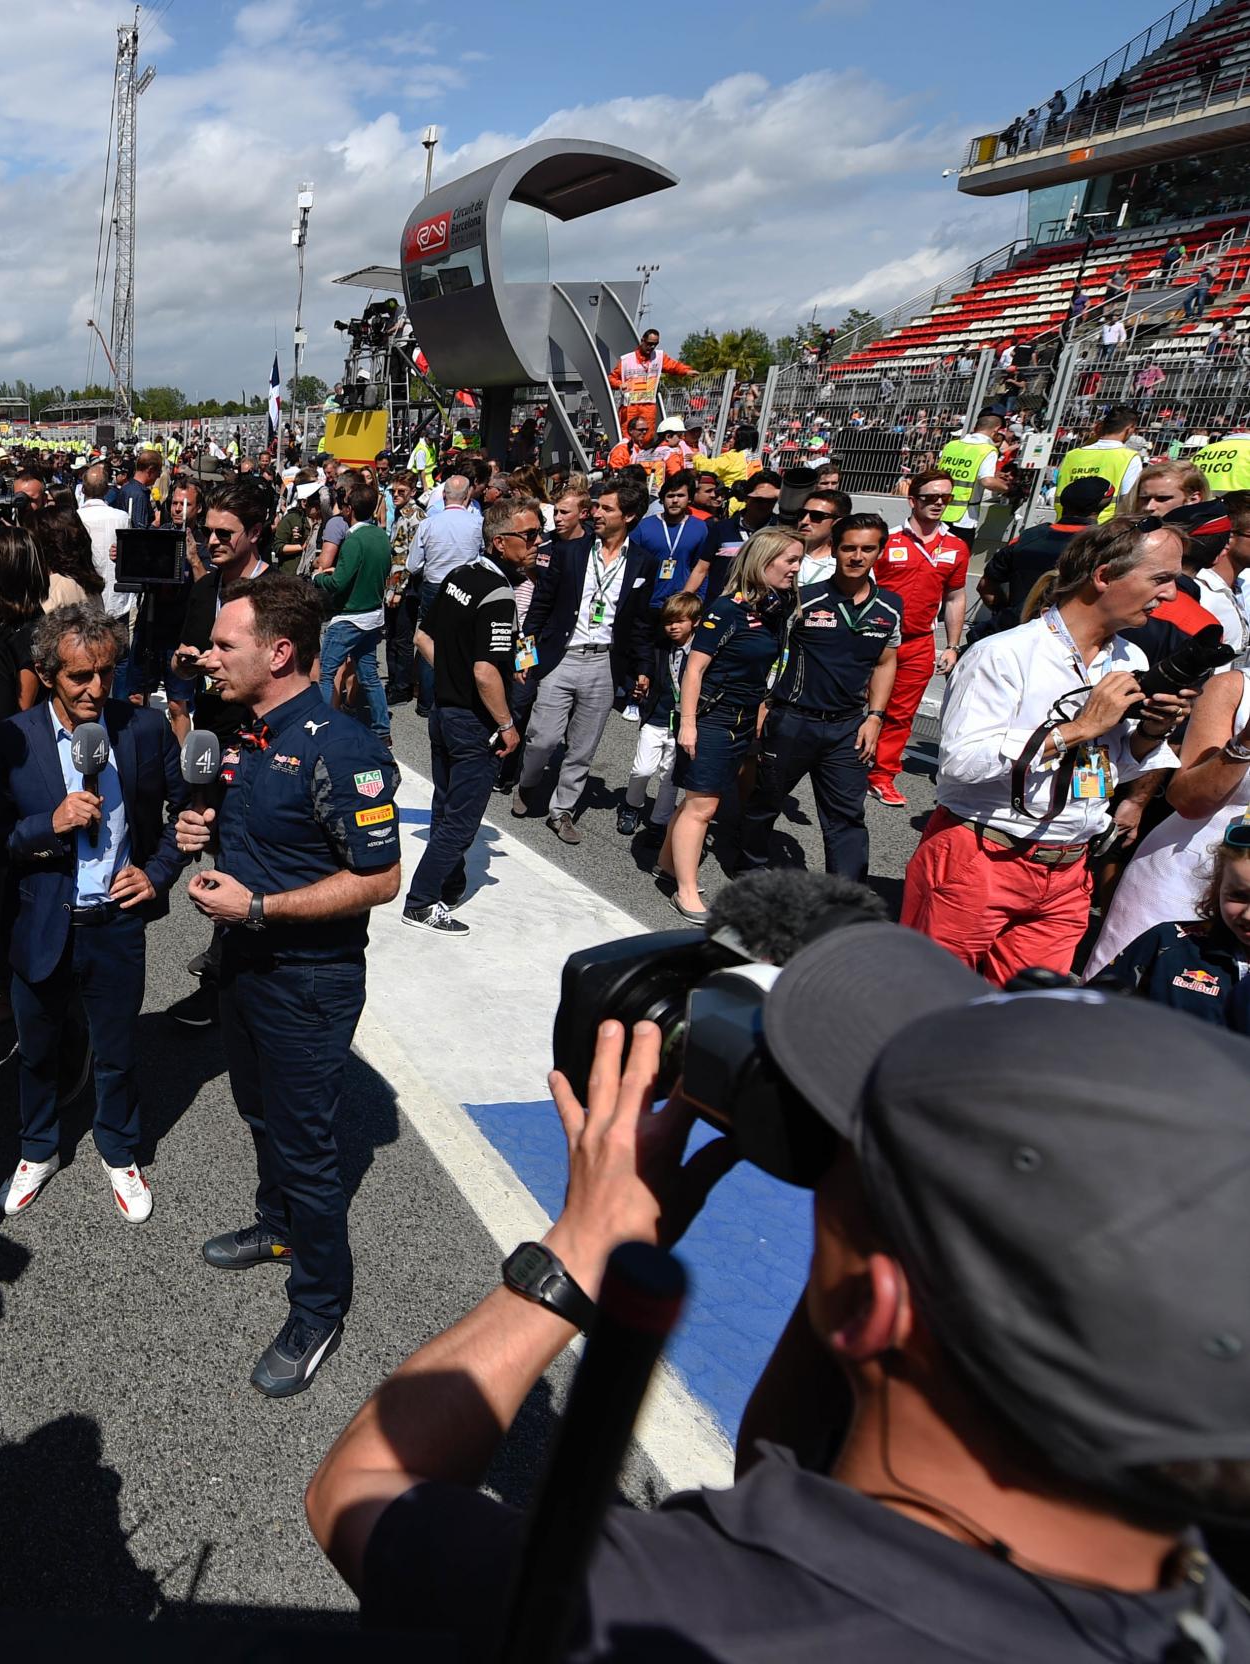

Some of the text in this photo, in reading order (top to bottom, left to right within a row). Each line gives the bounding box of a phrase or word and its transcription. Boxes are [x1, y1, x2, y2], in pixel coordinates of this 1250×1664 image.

[453, 199, 484, 220] Circuit de
[451, 215, 481, 234] Barcelona
[1071, 467, 1100, 475] GRUPO
[93, 738, 108, 765] 4
[196, 748, 216, 774] 4
[357, 771, 381, 783] TAG
[357, 781, 383, 796] HEUER
[360, 808, 391, 822] PIRELLI
